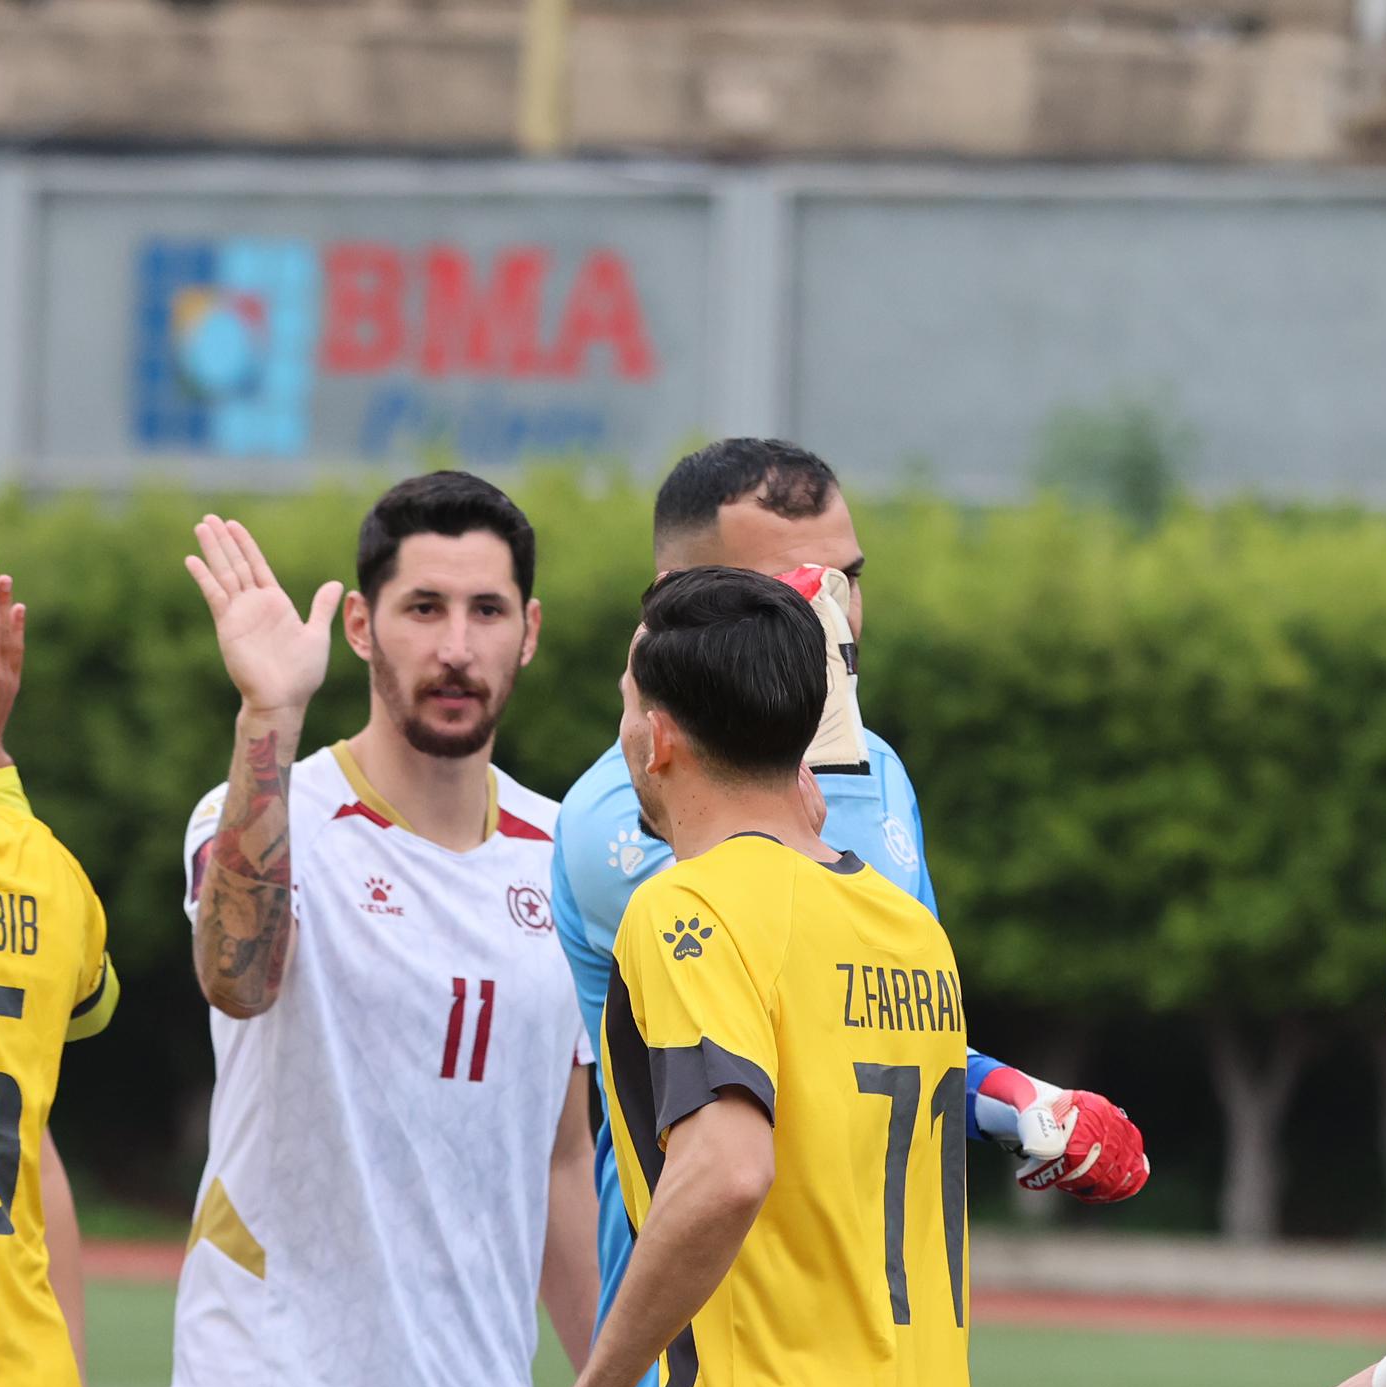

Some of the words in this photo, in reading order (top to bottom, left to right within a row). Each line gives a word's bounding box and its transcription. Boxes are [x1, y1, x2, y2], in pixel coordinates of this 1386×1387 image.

[317, 242, 659, 383] BMA
[676, 946, 700, 957] KELME
[439, 976, 496, 1083] 11
[852, 1061, 966, 1329] 71
